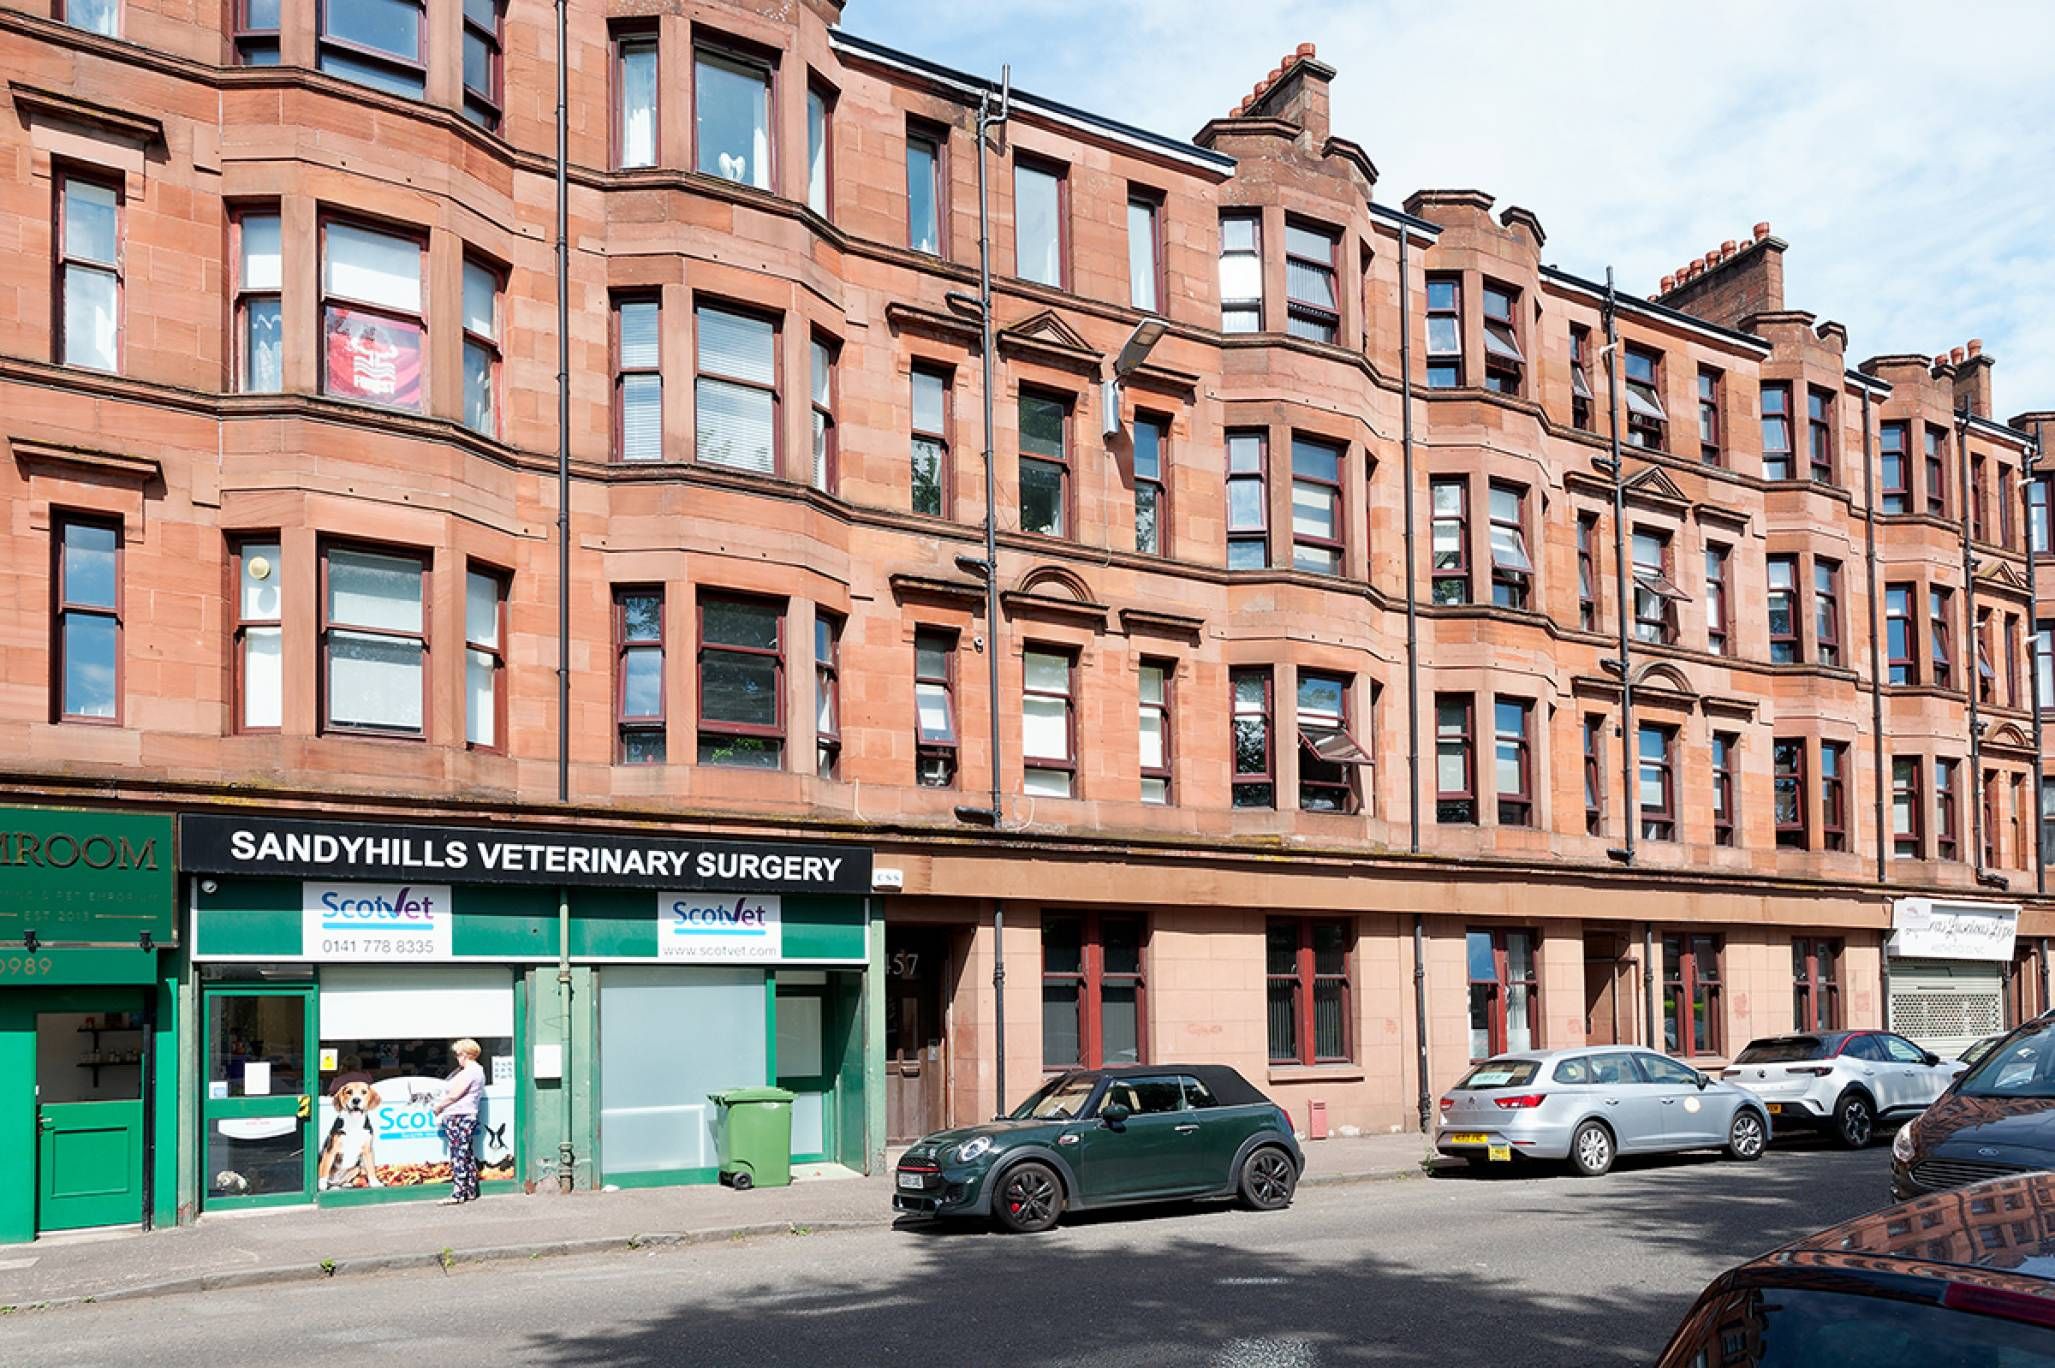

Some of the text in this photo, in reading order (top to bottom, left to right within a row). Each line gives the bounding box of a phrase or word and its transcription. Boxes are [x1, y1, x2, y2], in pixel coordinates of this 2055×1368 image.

[0, 832, 158, 871] ROOM
[231, 830, 842, 882] SANDYHILLS VETERINARY SURGERY
[24, 910, 50, 922] EST
[323, 940, 434, 953] 0141 778 8335
[662, 946, 777, 957] www.scotvet.com
[379, 1107, 436, 1130] Scot
